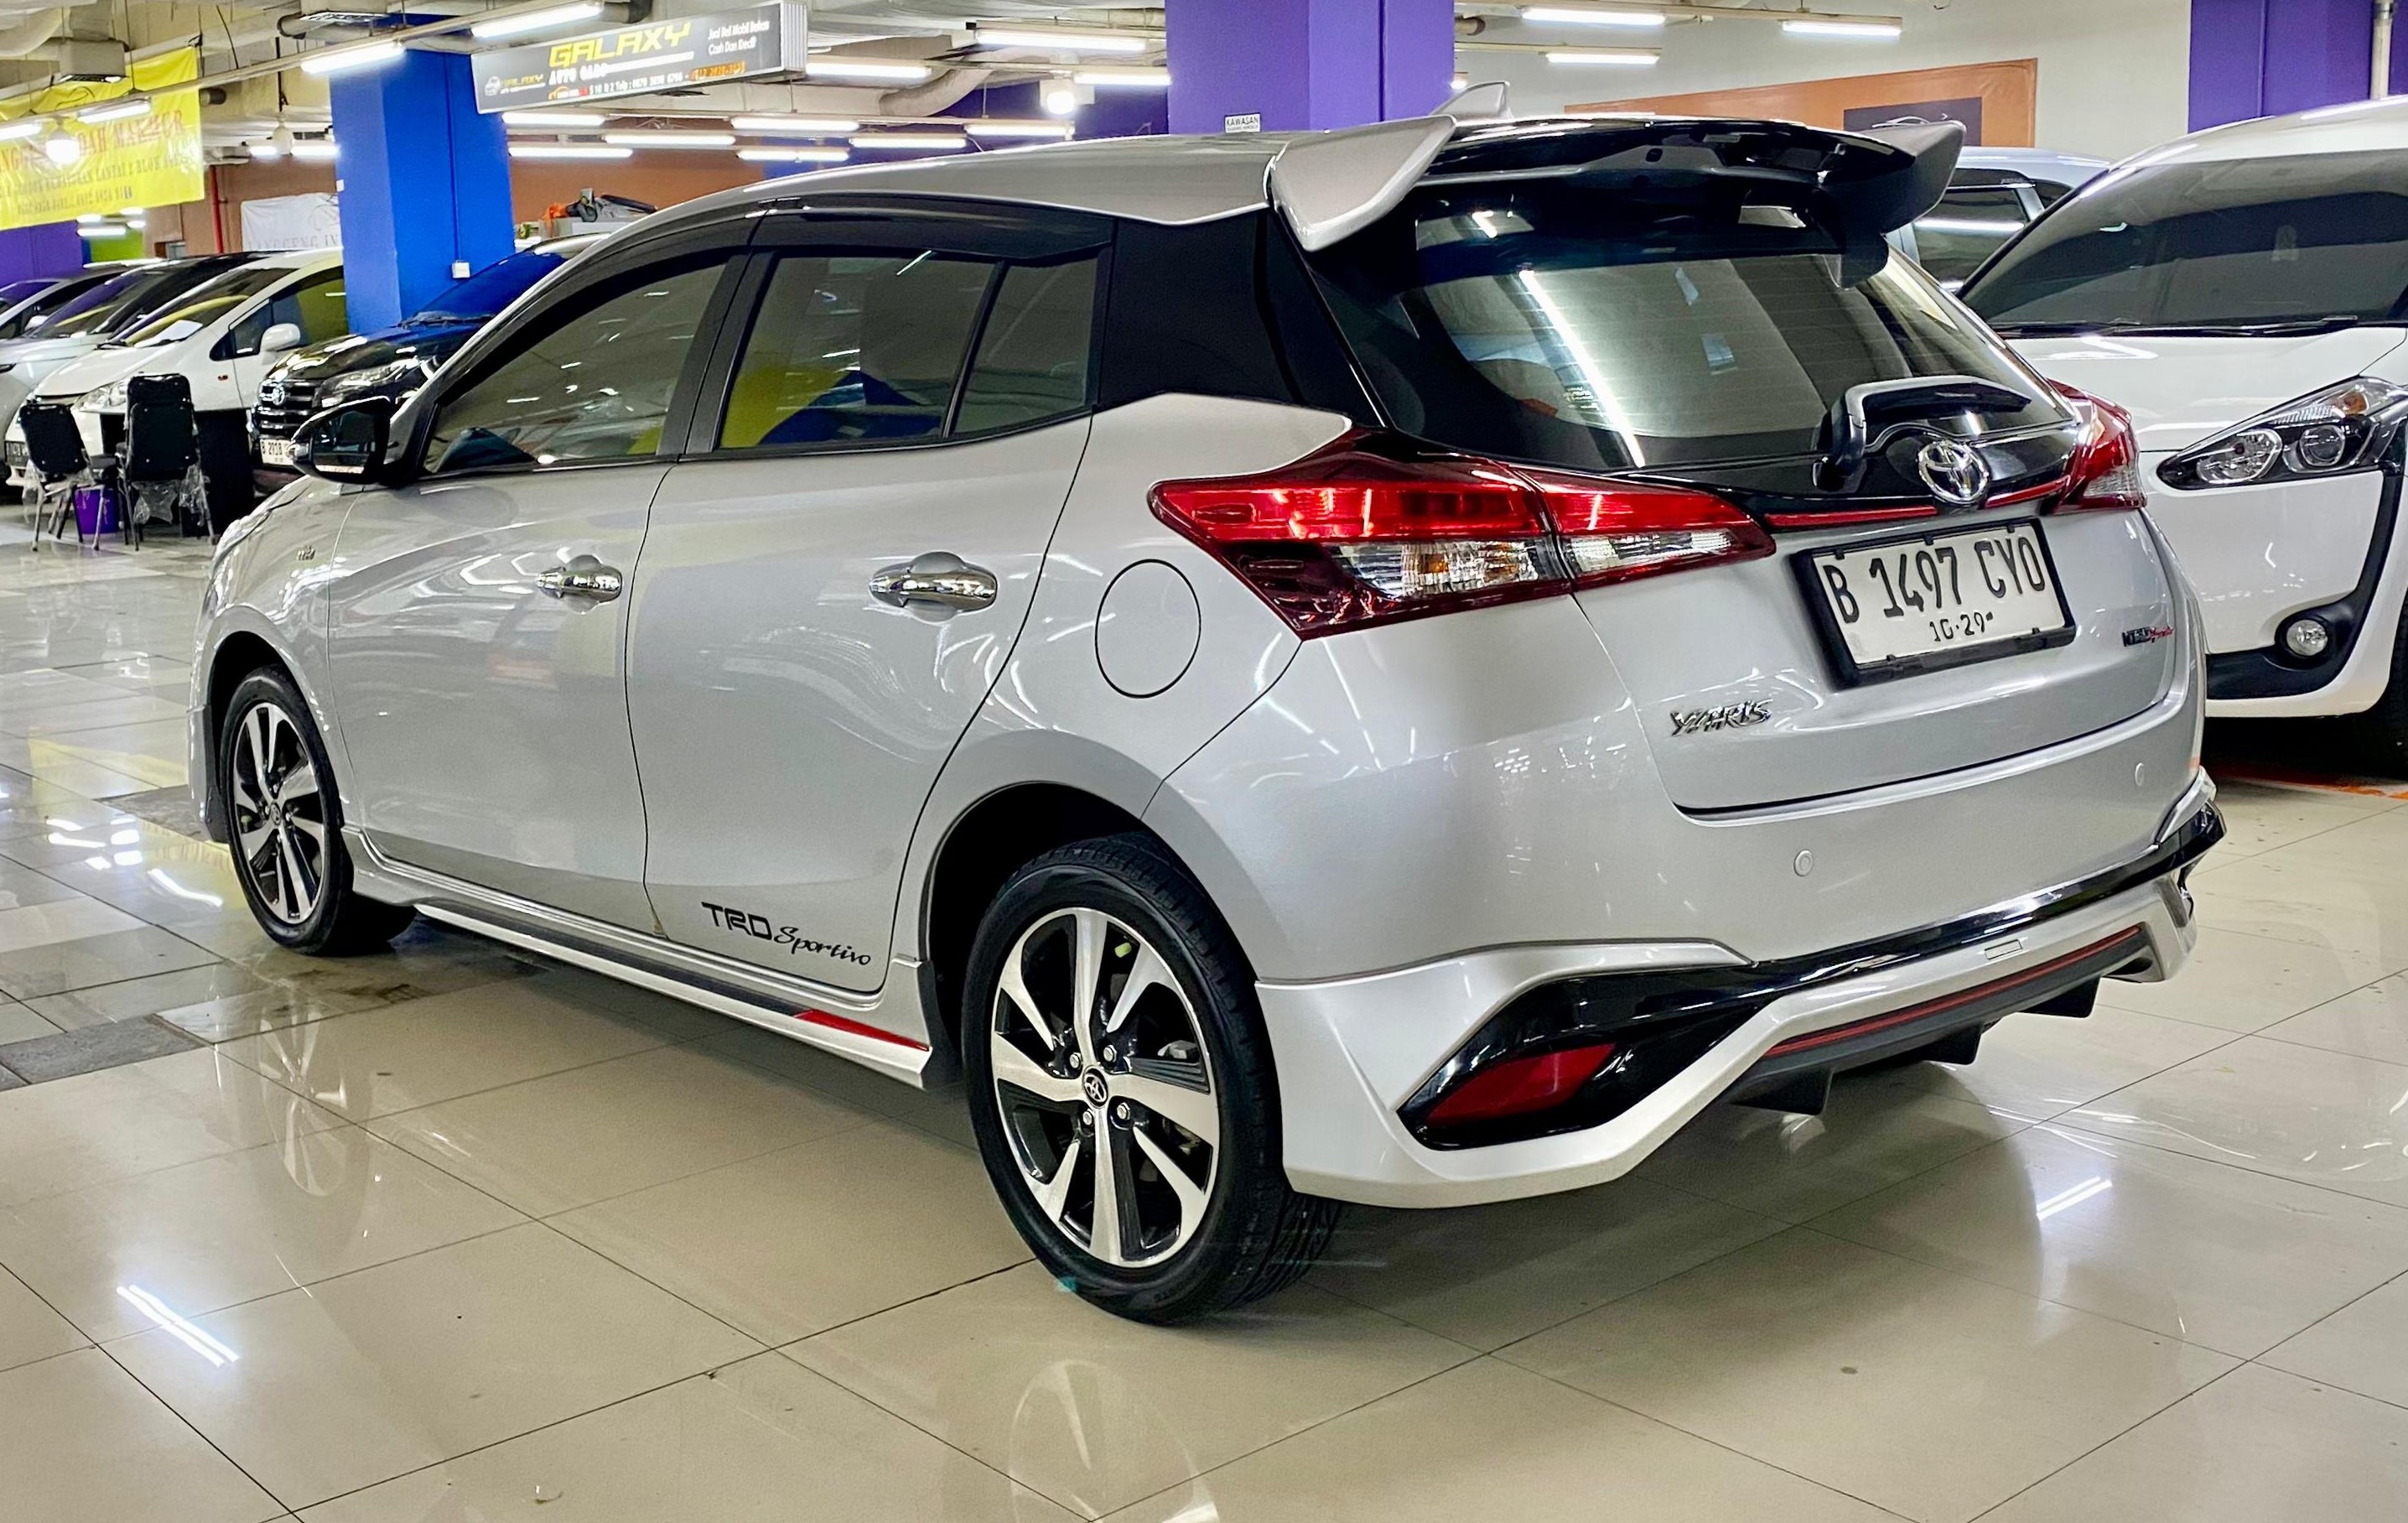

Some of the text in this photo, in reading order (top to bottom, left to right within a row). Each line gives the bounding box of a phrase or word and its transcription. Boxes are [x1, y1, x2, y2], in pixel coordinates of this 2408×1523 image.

[548, 21, 692, 69] GALAXY
[1823, 537, 2046, 624] B 1497 CYO
[1669, 699, 1774, 737] YARIS
[701, 902, 871, 965] TRD Sportivo
